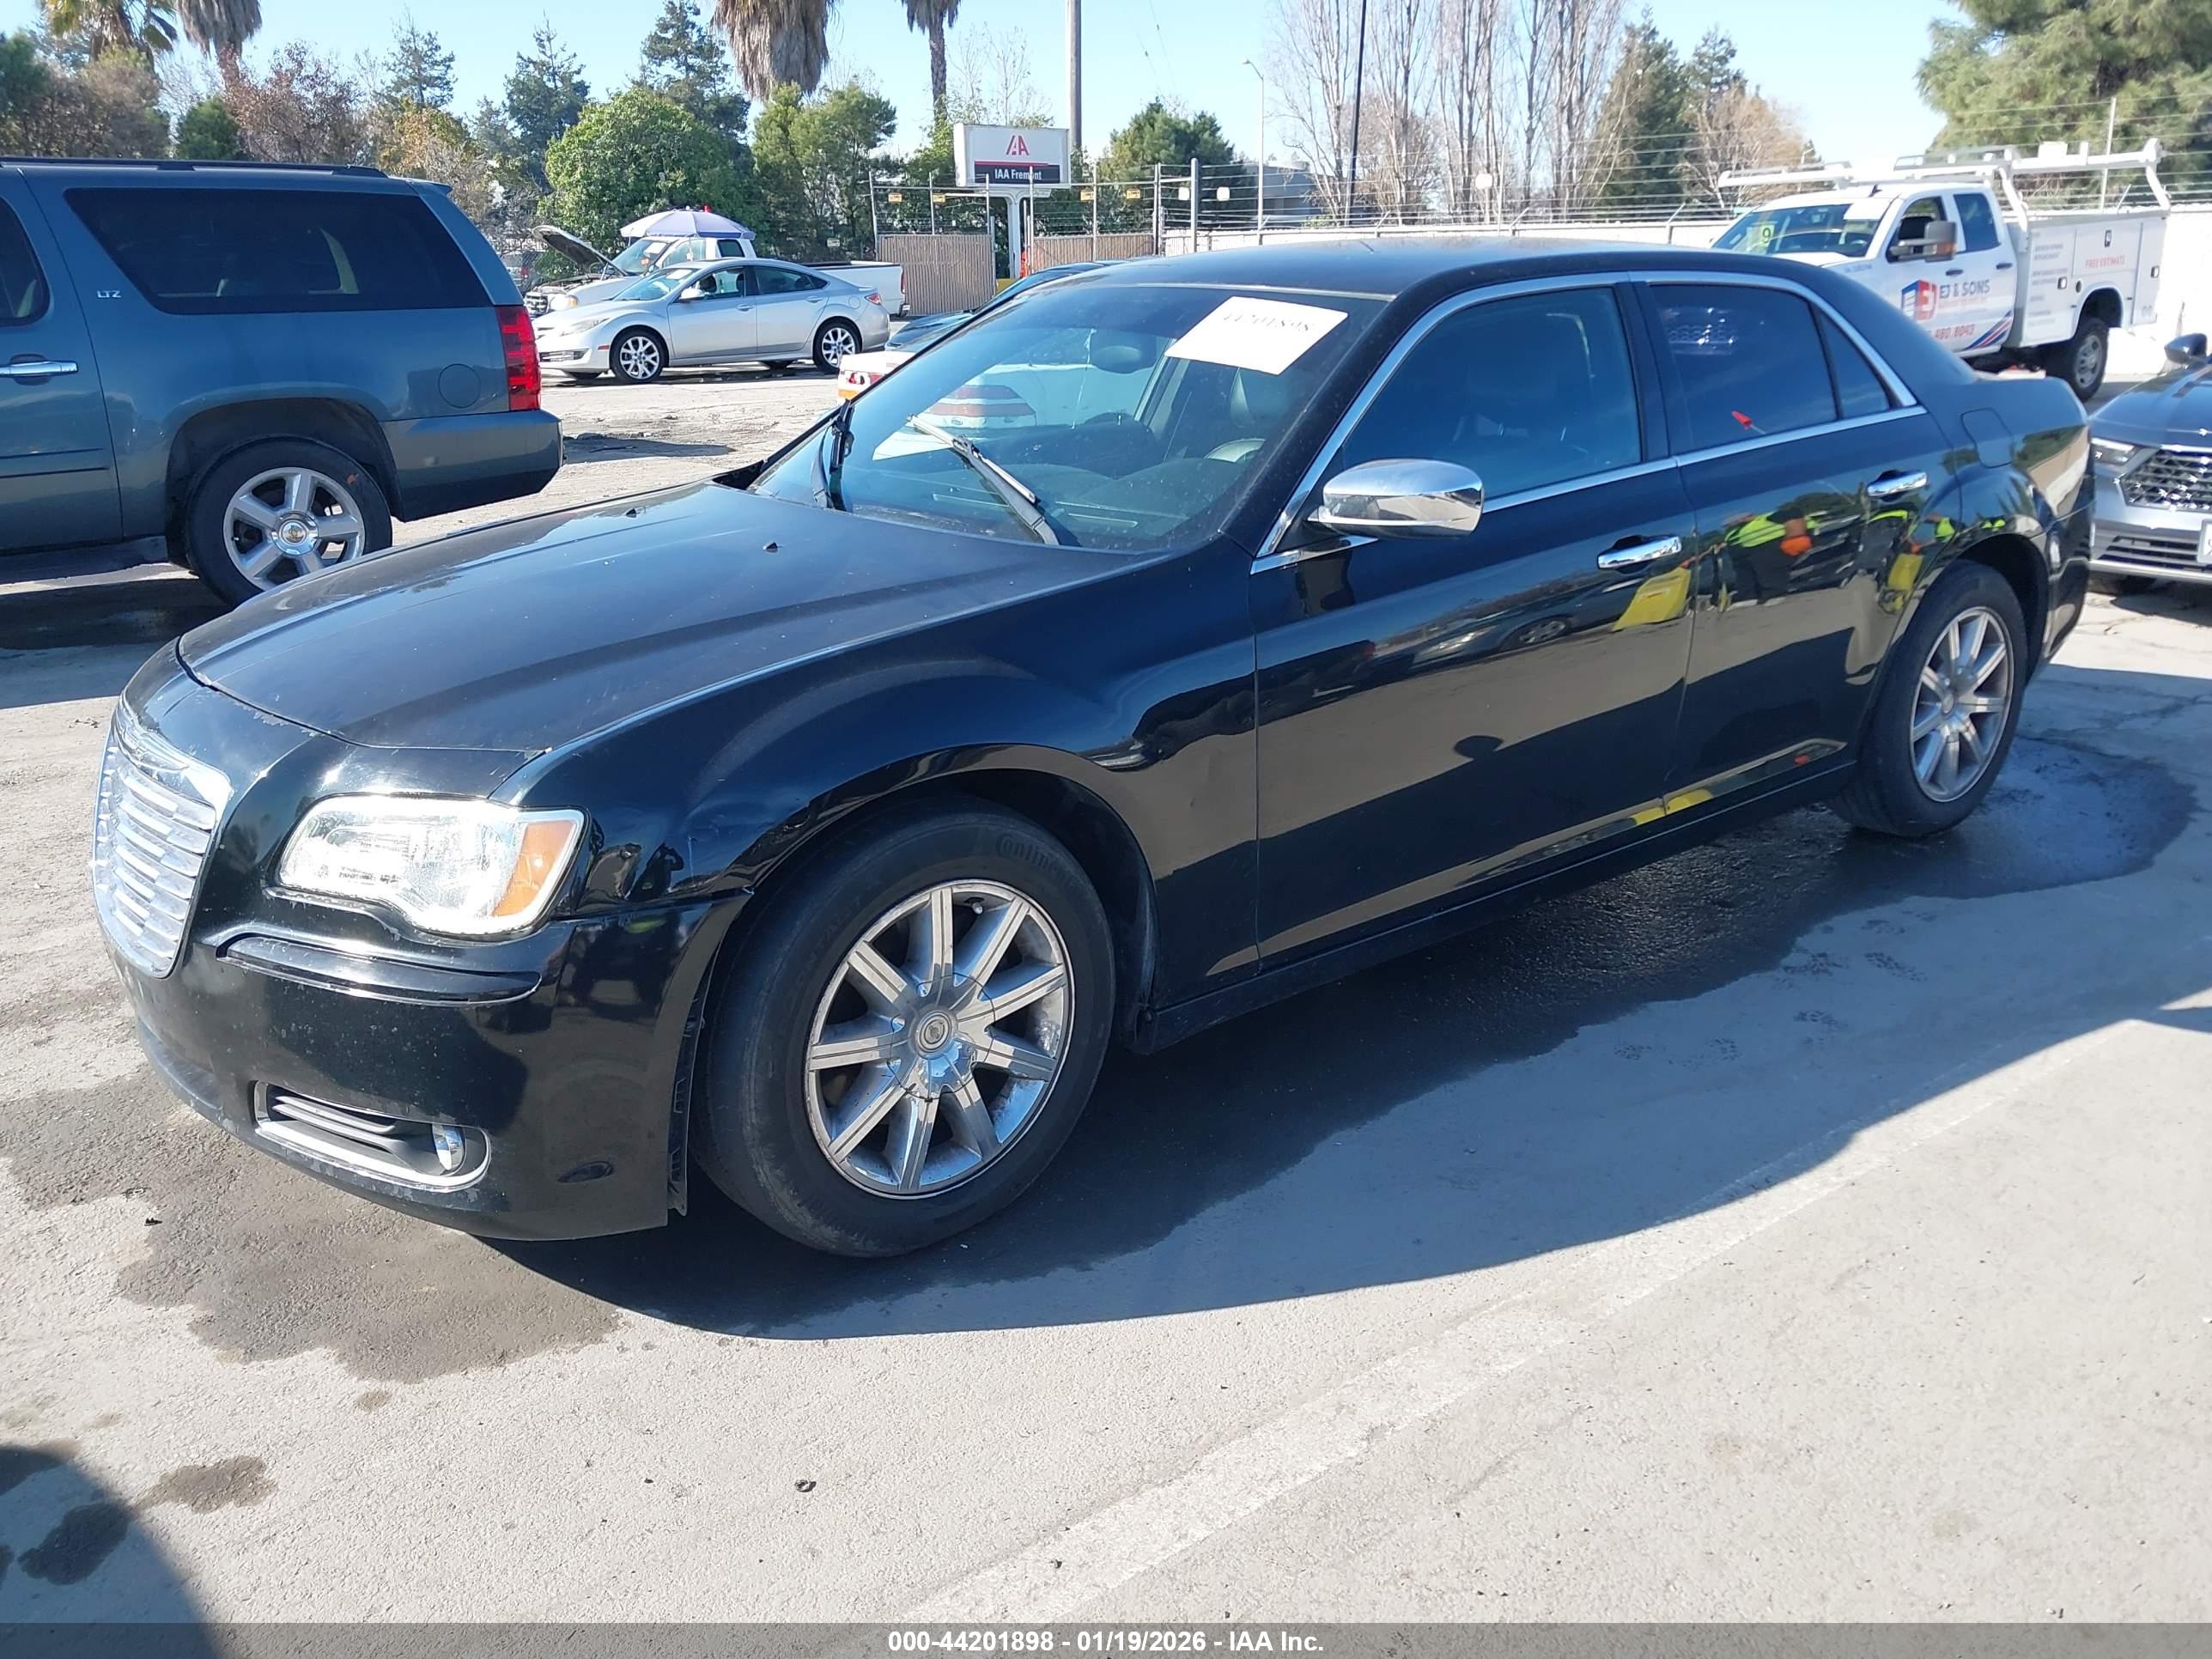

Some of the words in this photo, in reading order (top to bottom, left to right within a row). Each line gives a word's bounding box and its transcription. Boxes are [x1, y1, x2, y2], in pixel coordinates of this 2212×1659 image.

[994, 167, 1010, 179] IAA
[1762, 227, 1771, 244] 9
[96, 289, 122, 298] LTZ
[1939, 283, 1951, 299] EJ
[1954, 283, 1960, 297] &
[1961, 279, 1990, 296] SONS
